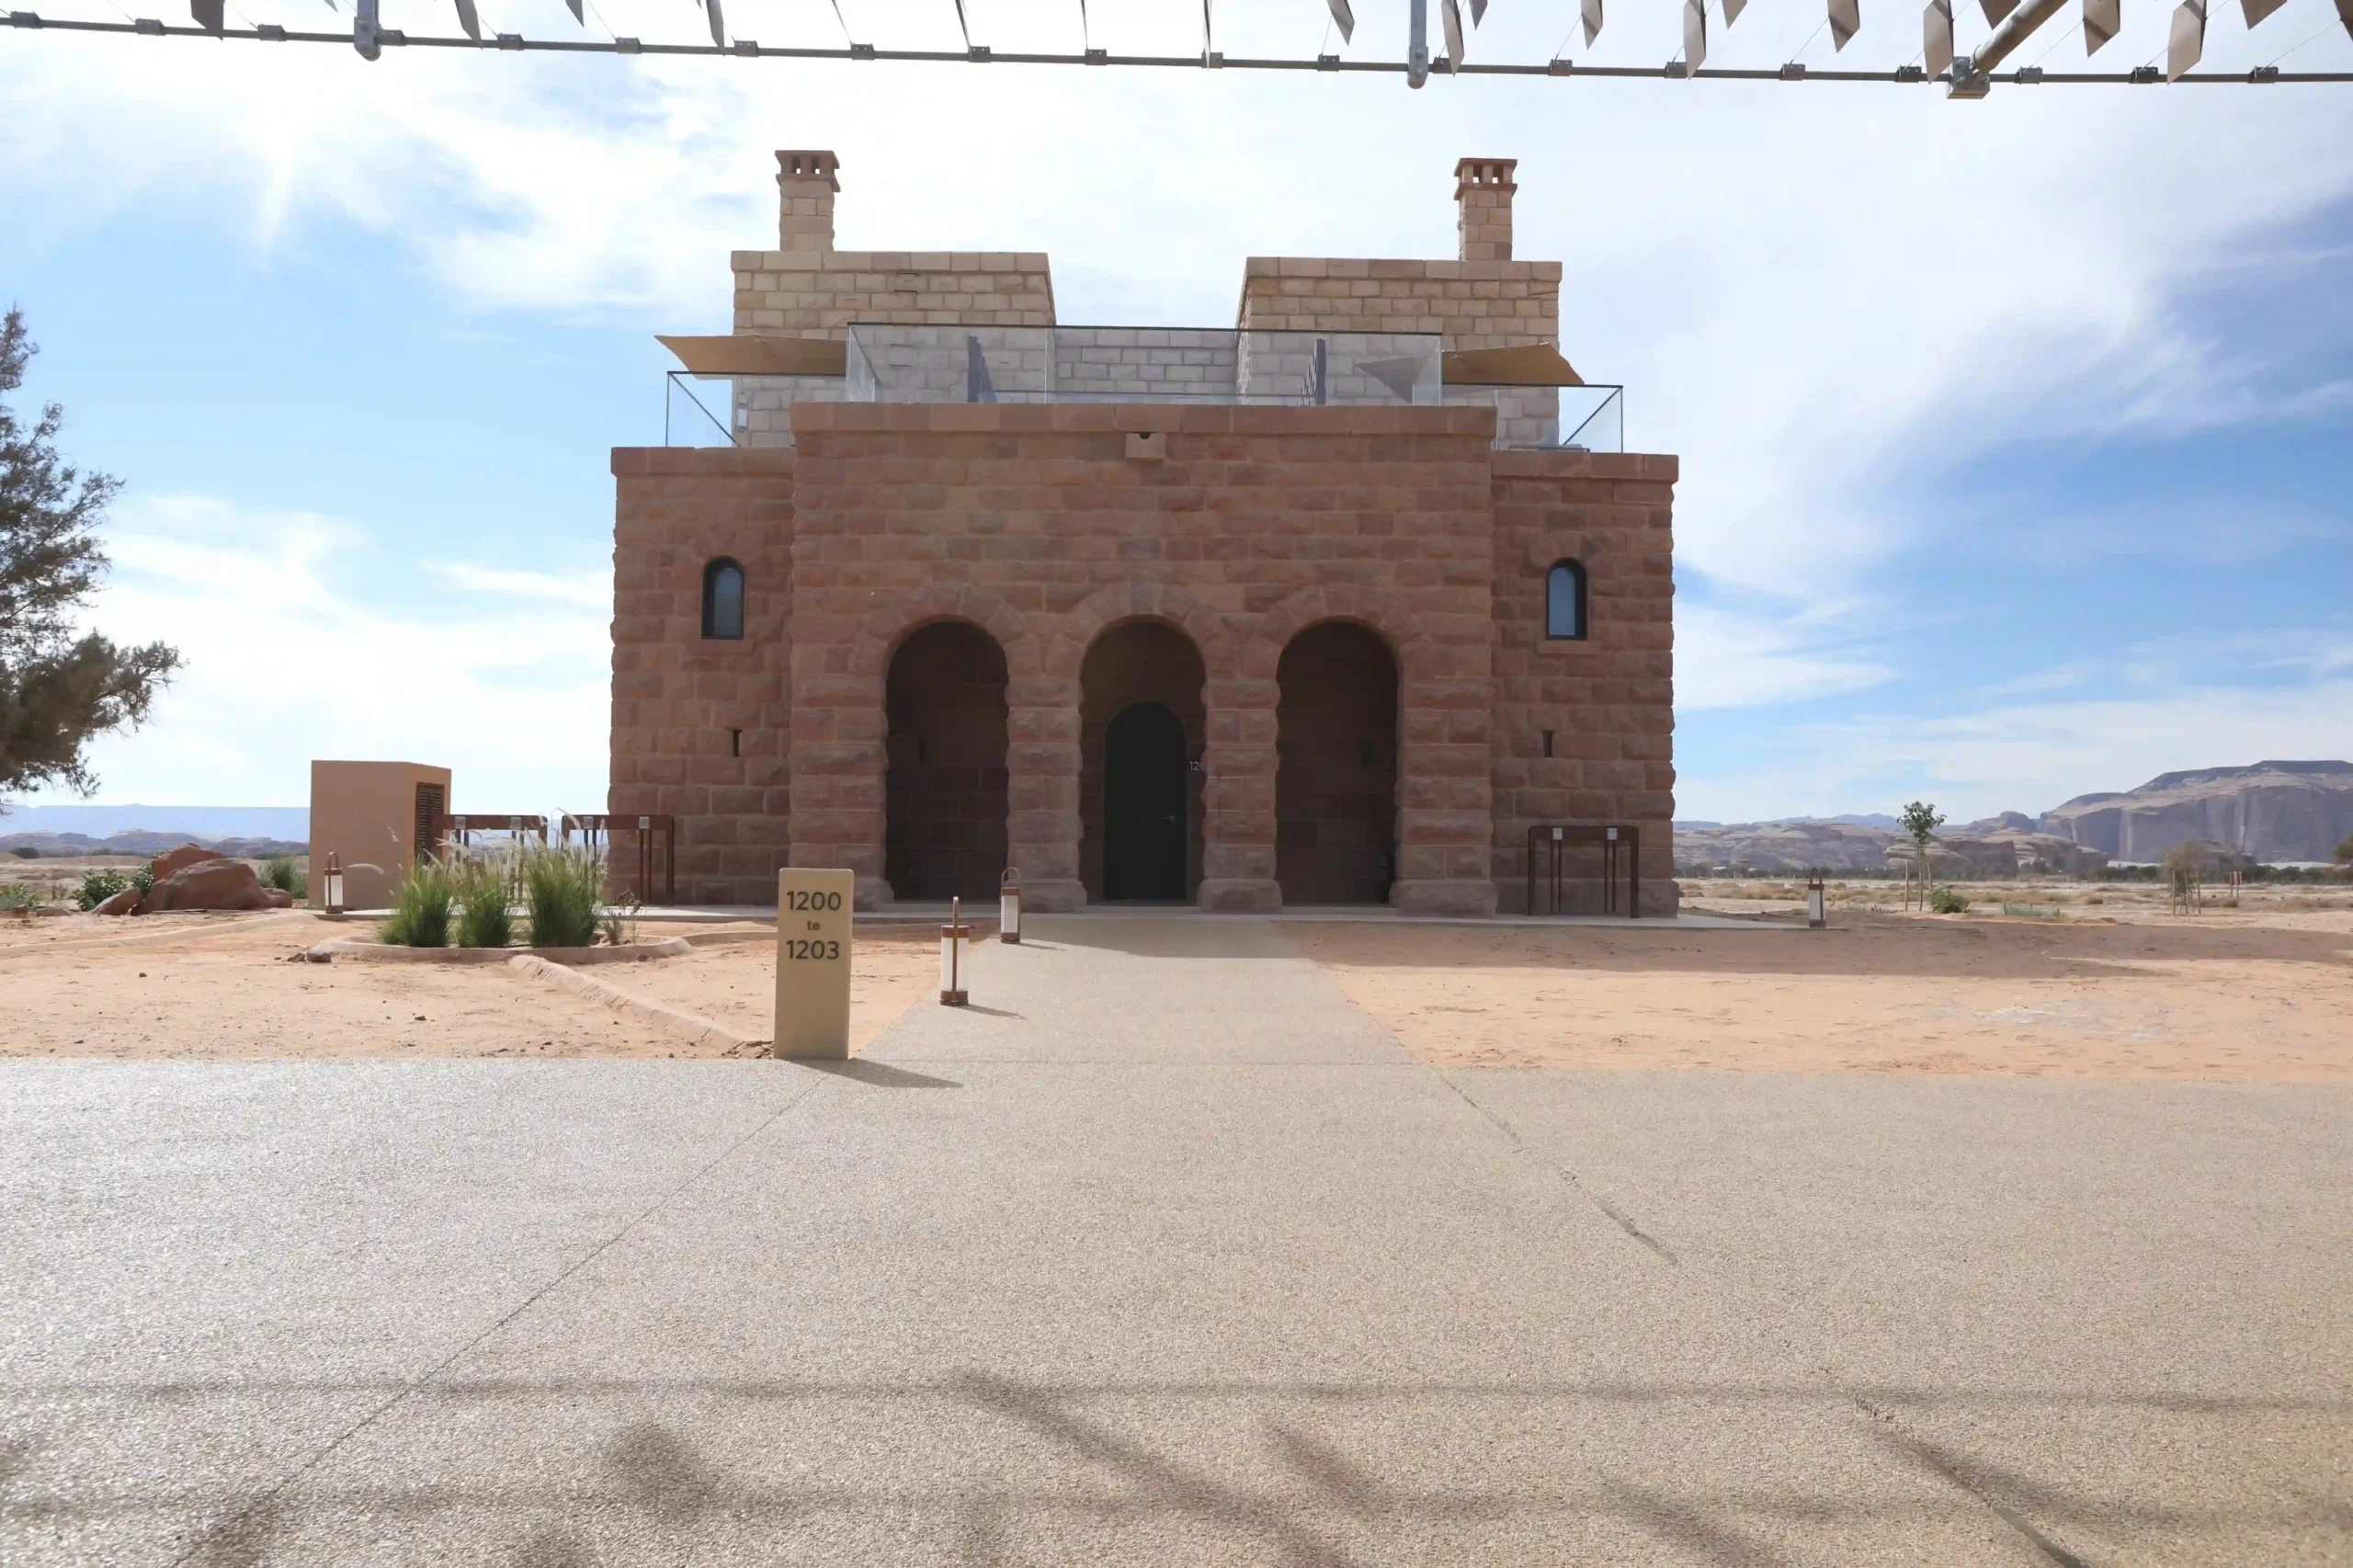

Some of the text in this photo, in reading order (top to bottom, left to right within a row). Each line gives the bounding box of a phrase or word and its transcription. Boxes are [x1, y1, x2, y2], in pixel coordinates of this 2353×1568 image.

[786, 891, 842, 911] 1200
[807, 920, 820, 931] to
[786, 939, 840, 960] 1203
